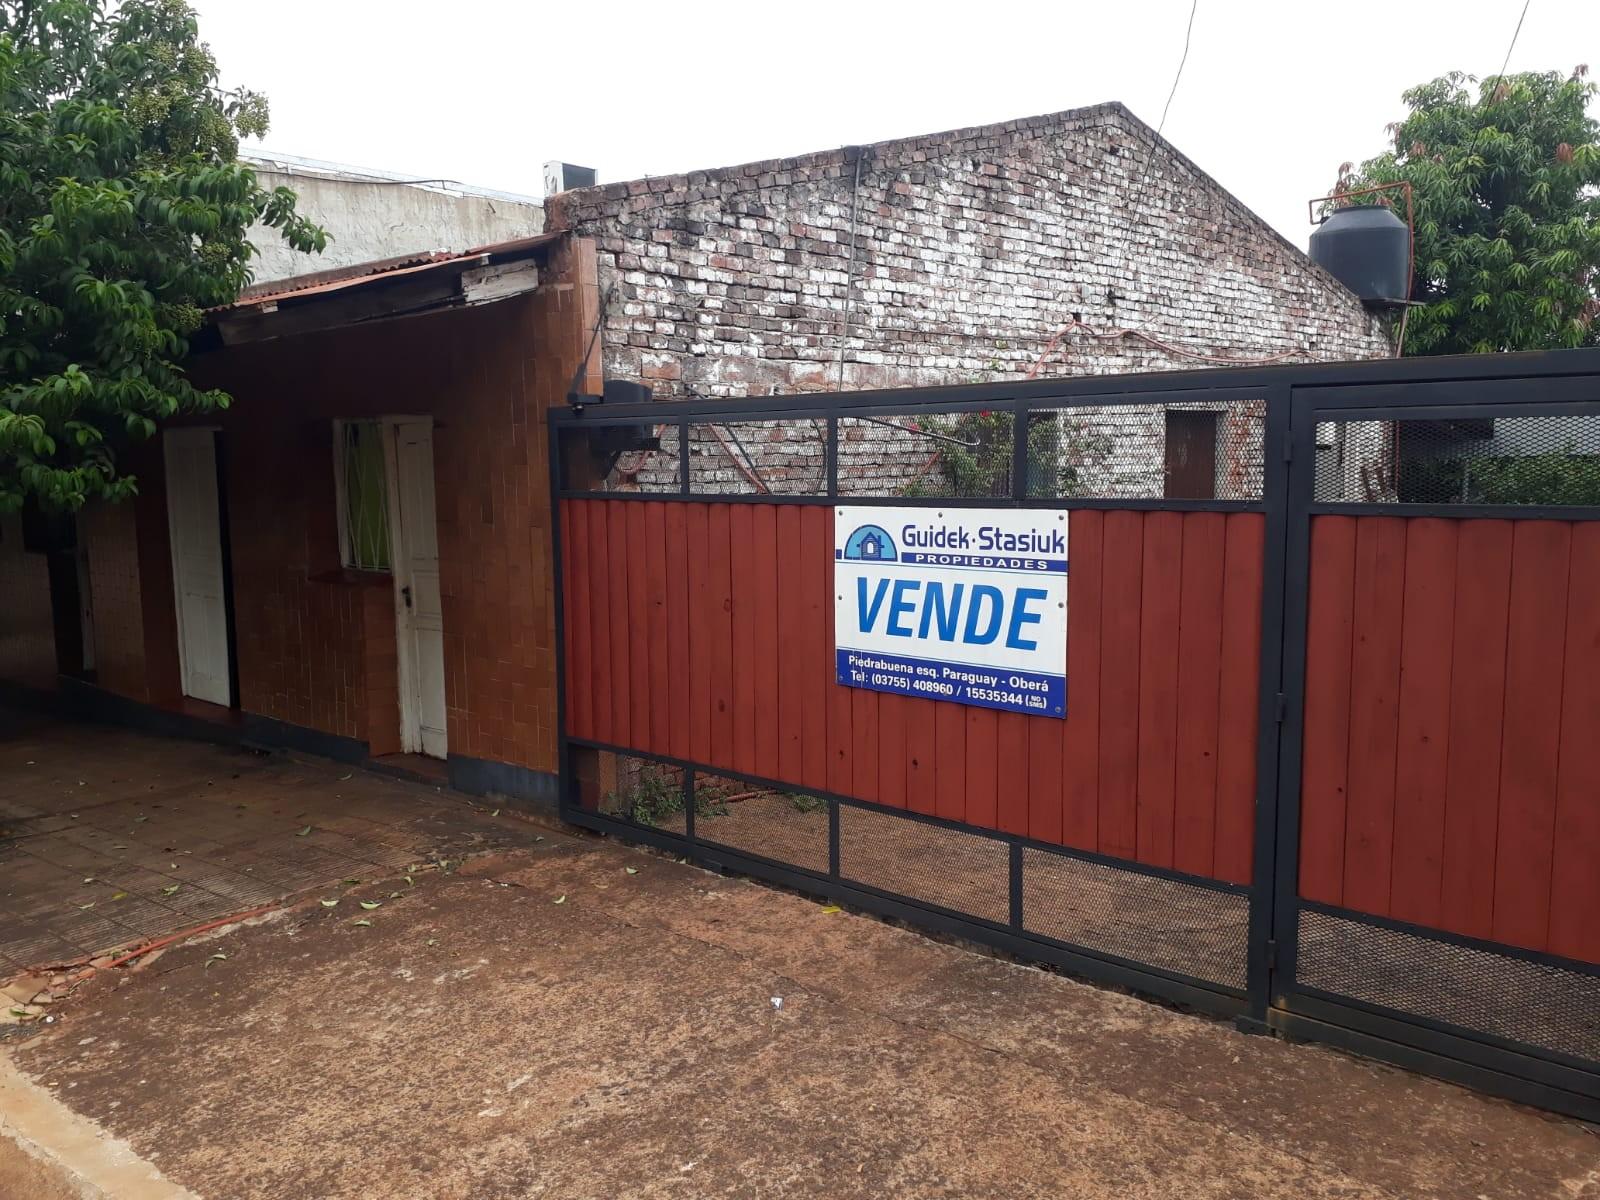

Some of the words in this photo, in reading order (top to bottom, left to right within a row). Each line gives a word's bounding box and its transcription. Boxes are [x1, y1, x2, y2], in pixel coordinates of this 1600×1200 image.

[902, 525, 970, 549] Guidek
[978, 527, 1065, 553] Stasiuk
[915, 554, 1048, 570] PROPIEDADES
[857, 577, 1048, 651] VENDE
[848, 656, 913, 674] Piedrabuena
[916, 666, 939, 678] esq.
[943, 668, 997, 687] Paraguay
[1009, 676, 1049, 692] Oberá
[851, 670, 869, 683] Tel:
[872, 674, 910, 690] (03755)
[913, 681, 953, 696] 408960
[966, 687, 1023, 705] 15535344
